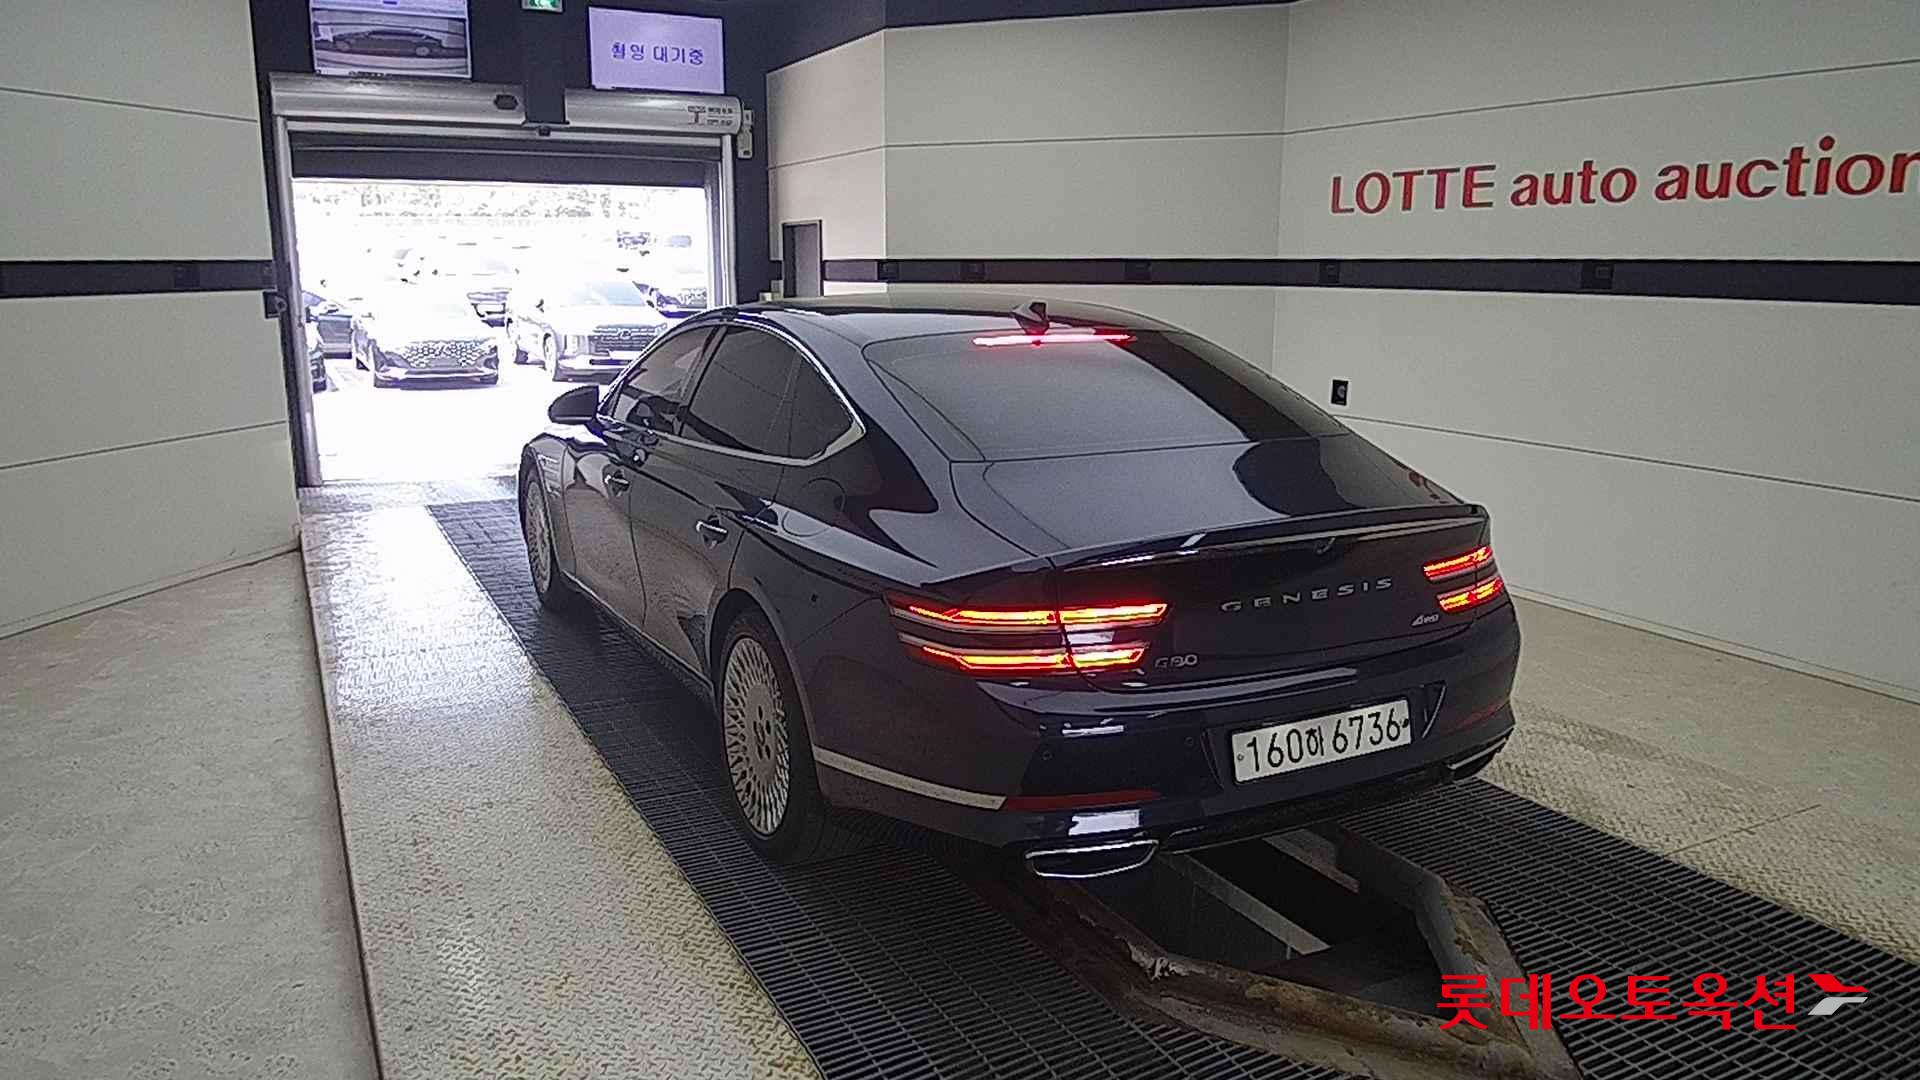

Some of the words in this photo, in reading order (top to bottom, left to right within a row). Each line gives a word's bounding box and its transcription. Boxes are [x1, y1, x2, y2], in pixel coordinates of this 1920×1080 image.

[653, 46, 704, 66] 대기중
[1331, 164, 1497, 215] LOTTE
[1510, 160, 1638, 207] auto
[1221, 578, 1393, 612] GENESIS
